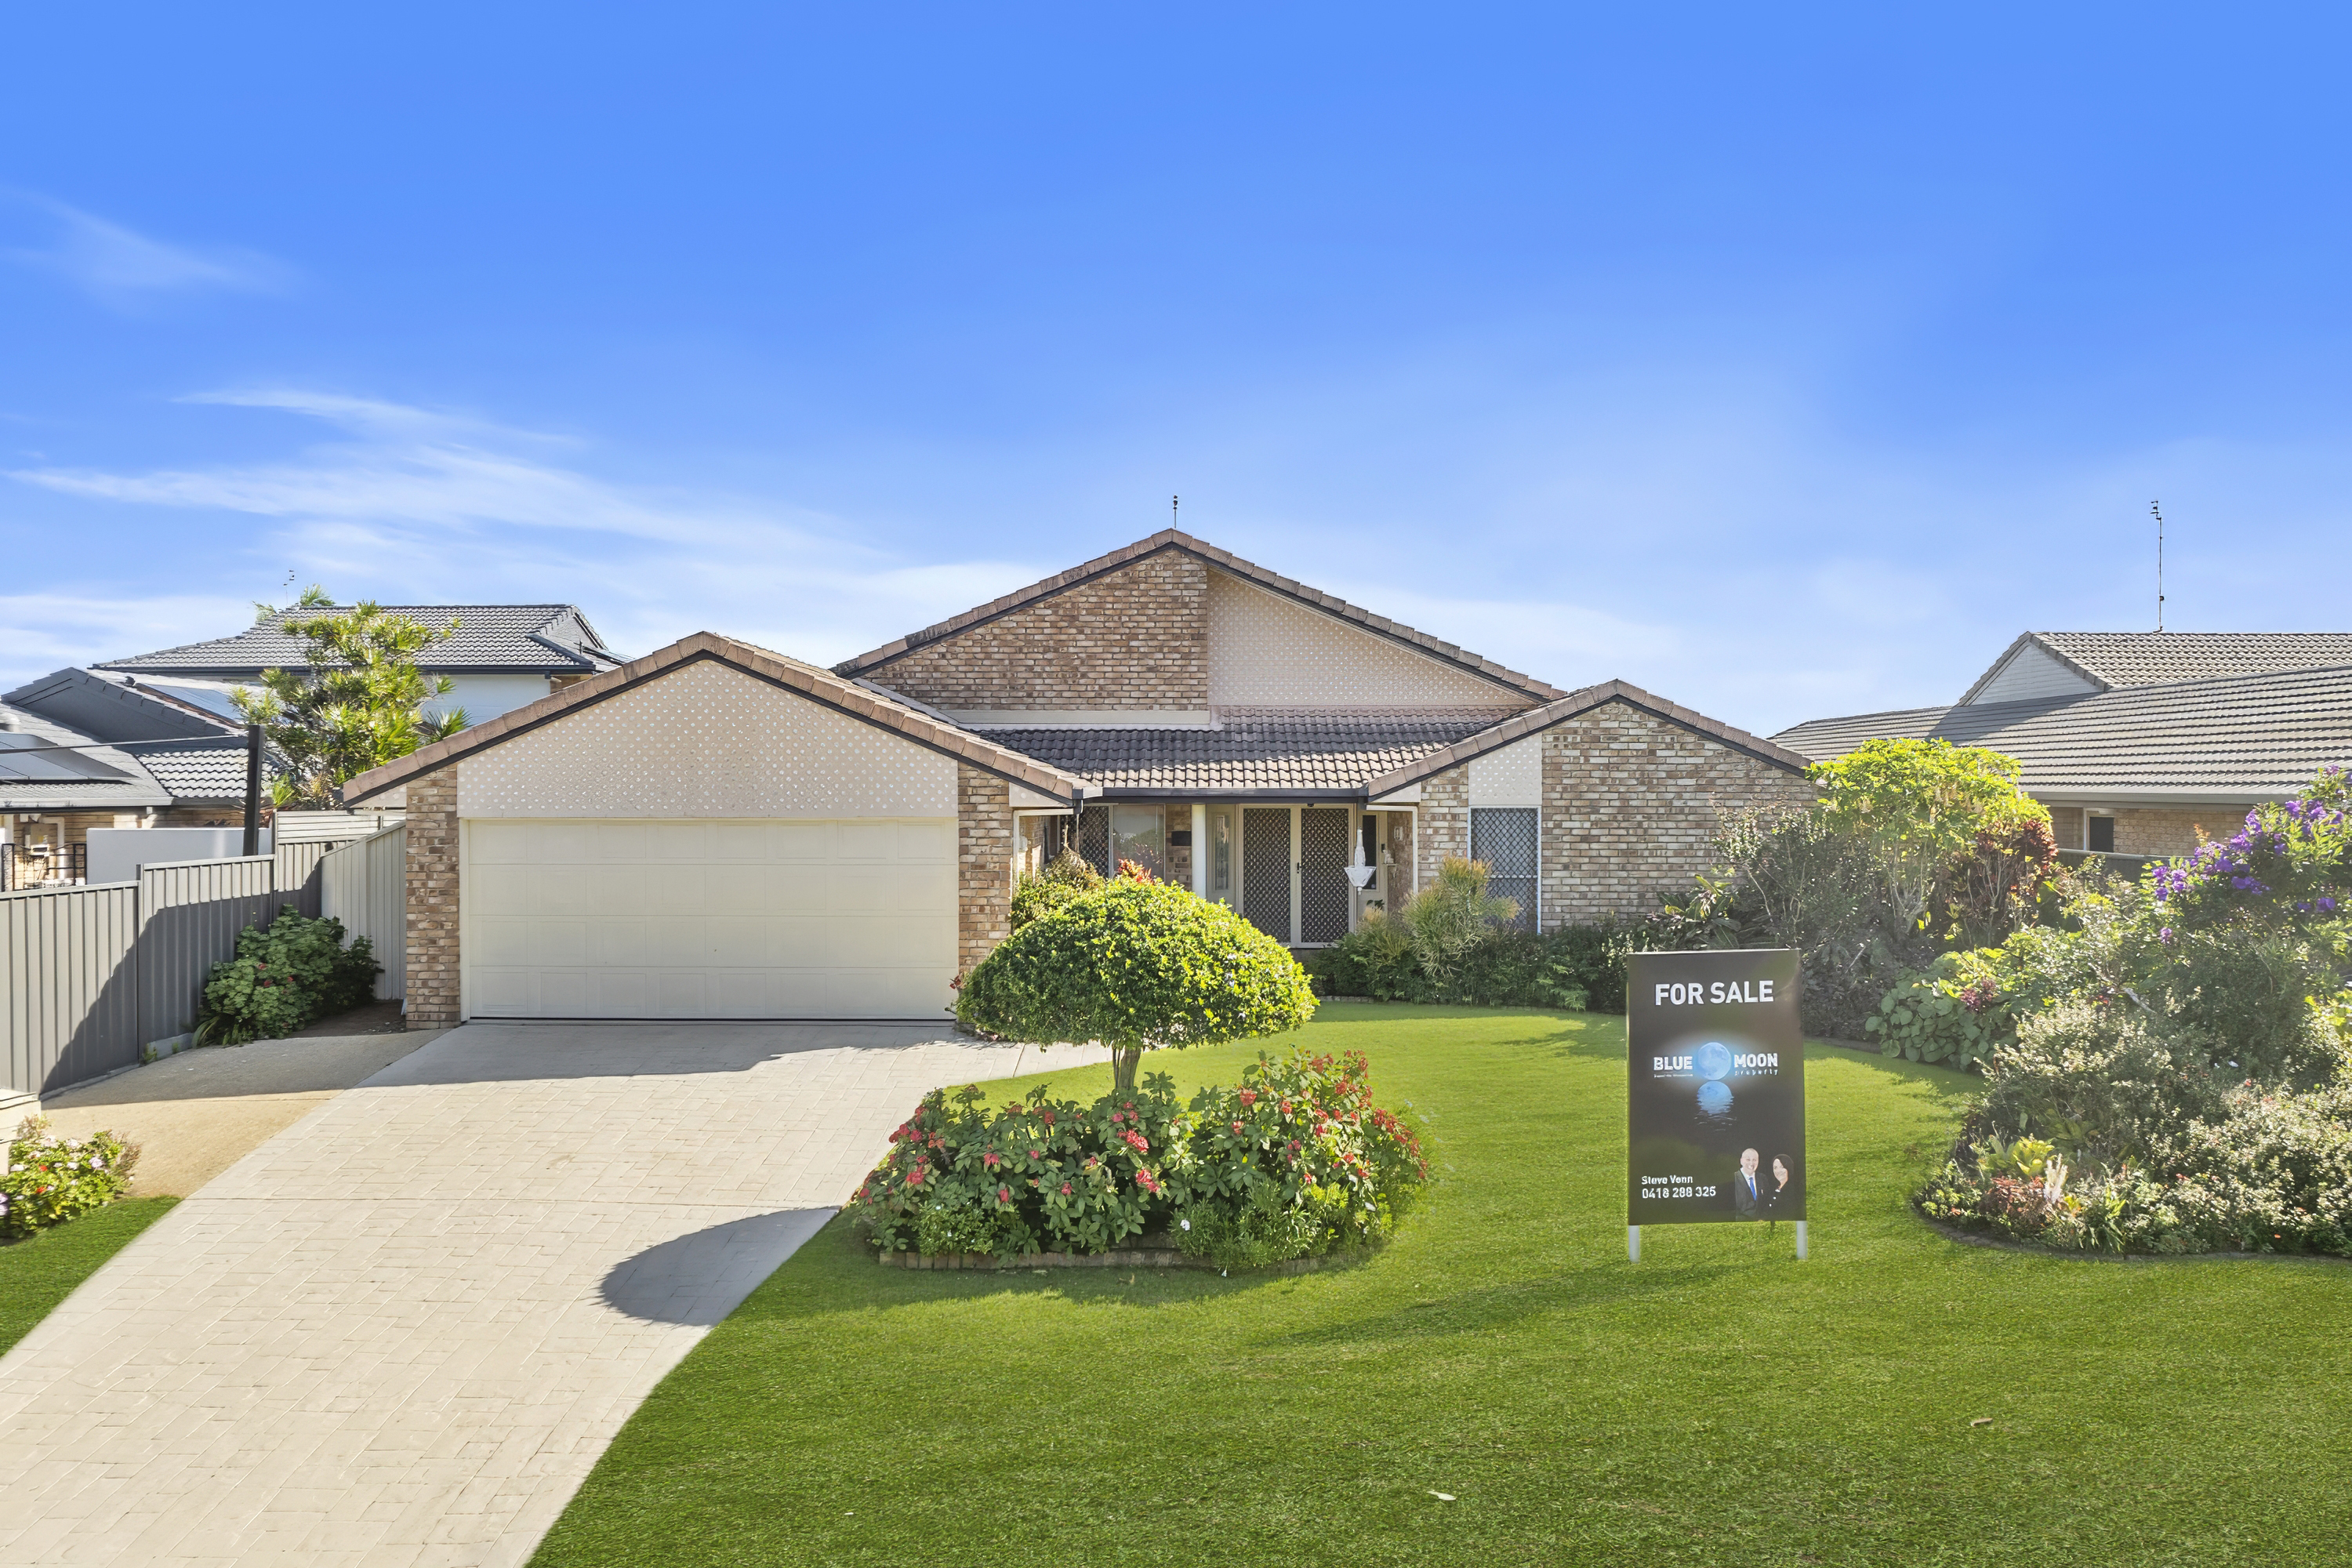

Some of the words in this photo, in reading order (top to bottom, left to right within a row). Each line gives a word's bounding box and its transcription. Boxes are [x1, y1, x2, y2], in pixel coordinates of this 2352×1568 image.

[1655, 982, 1704, 1006] FOR
[1710, 980, 1774, 1004] SALE
[1653, 1056, 1693, 1070] BLUE
[1734, 1053, 1778, 1068] MOON
